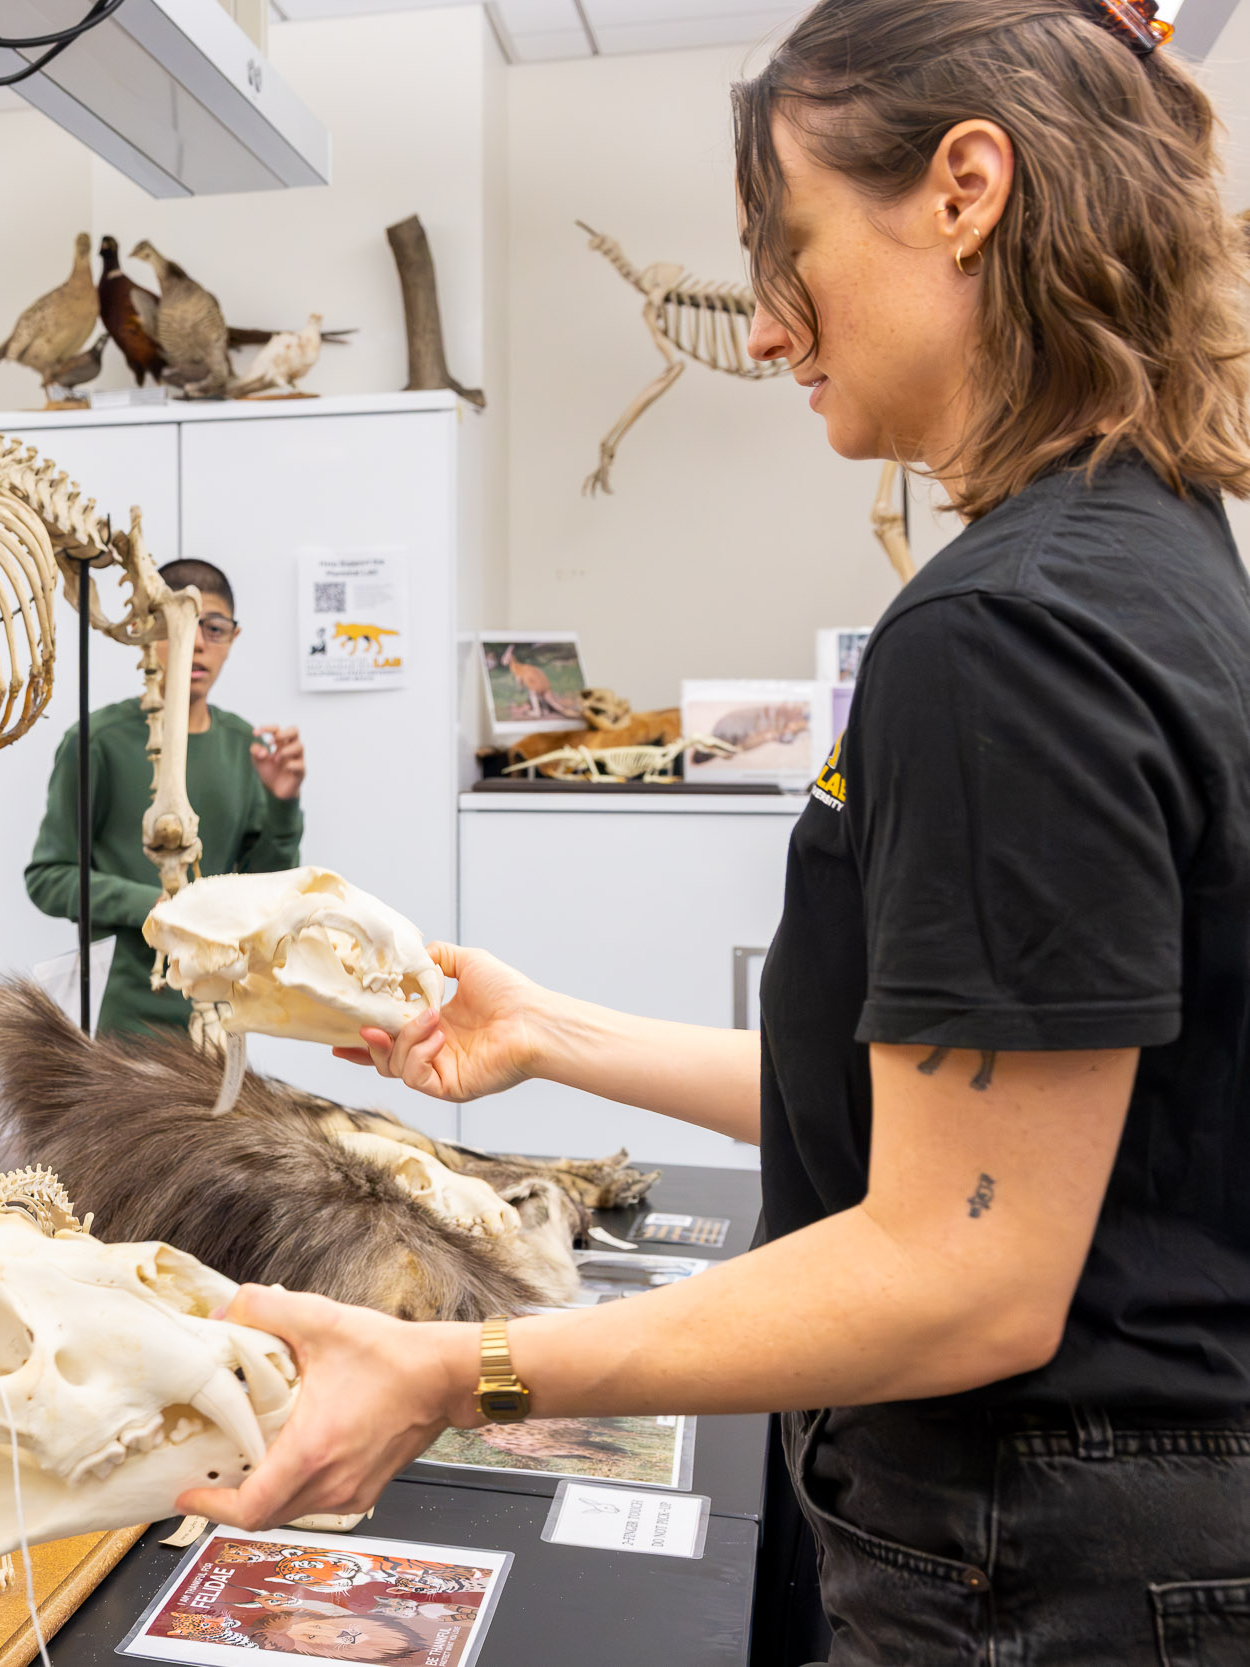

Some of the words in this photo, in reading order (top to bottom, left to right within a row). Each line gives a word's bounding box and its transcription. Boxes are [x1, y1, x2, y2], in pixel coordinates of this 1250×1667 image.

[373, 657, 401, 668] LAB
[628, 1499, 644, 1520] TOUCH
[622, 1521, 638, 1546] 2-FINGER
[654, 1525, 668, 1538] NOT
[651, 1538, 665, 1547] DO
[200, 1562, 213, 1571] FOR
[184, 1572, 208, 1595] THANKFUL
[189, 1567, 236, 1609] FELIDAE
[179, 1595, 191, 1603] AM
[428, 1627, 452, 1656] THANKFUL
[425, 1656, 440, 1666] BE
